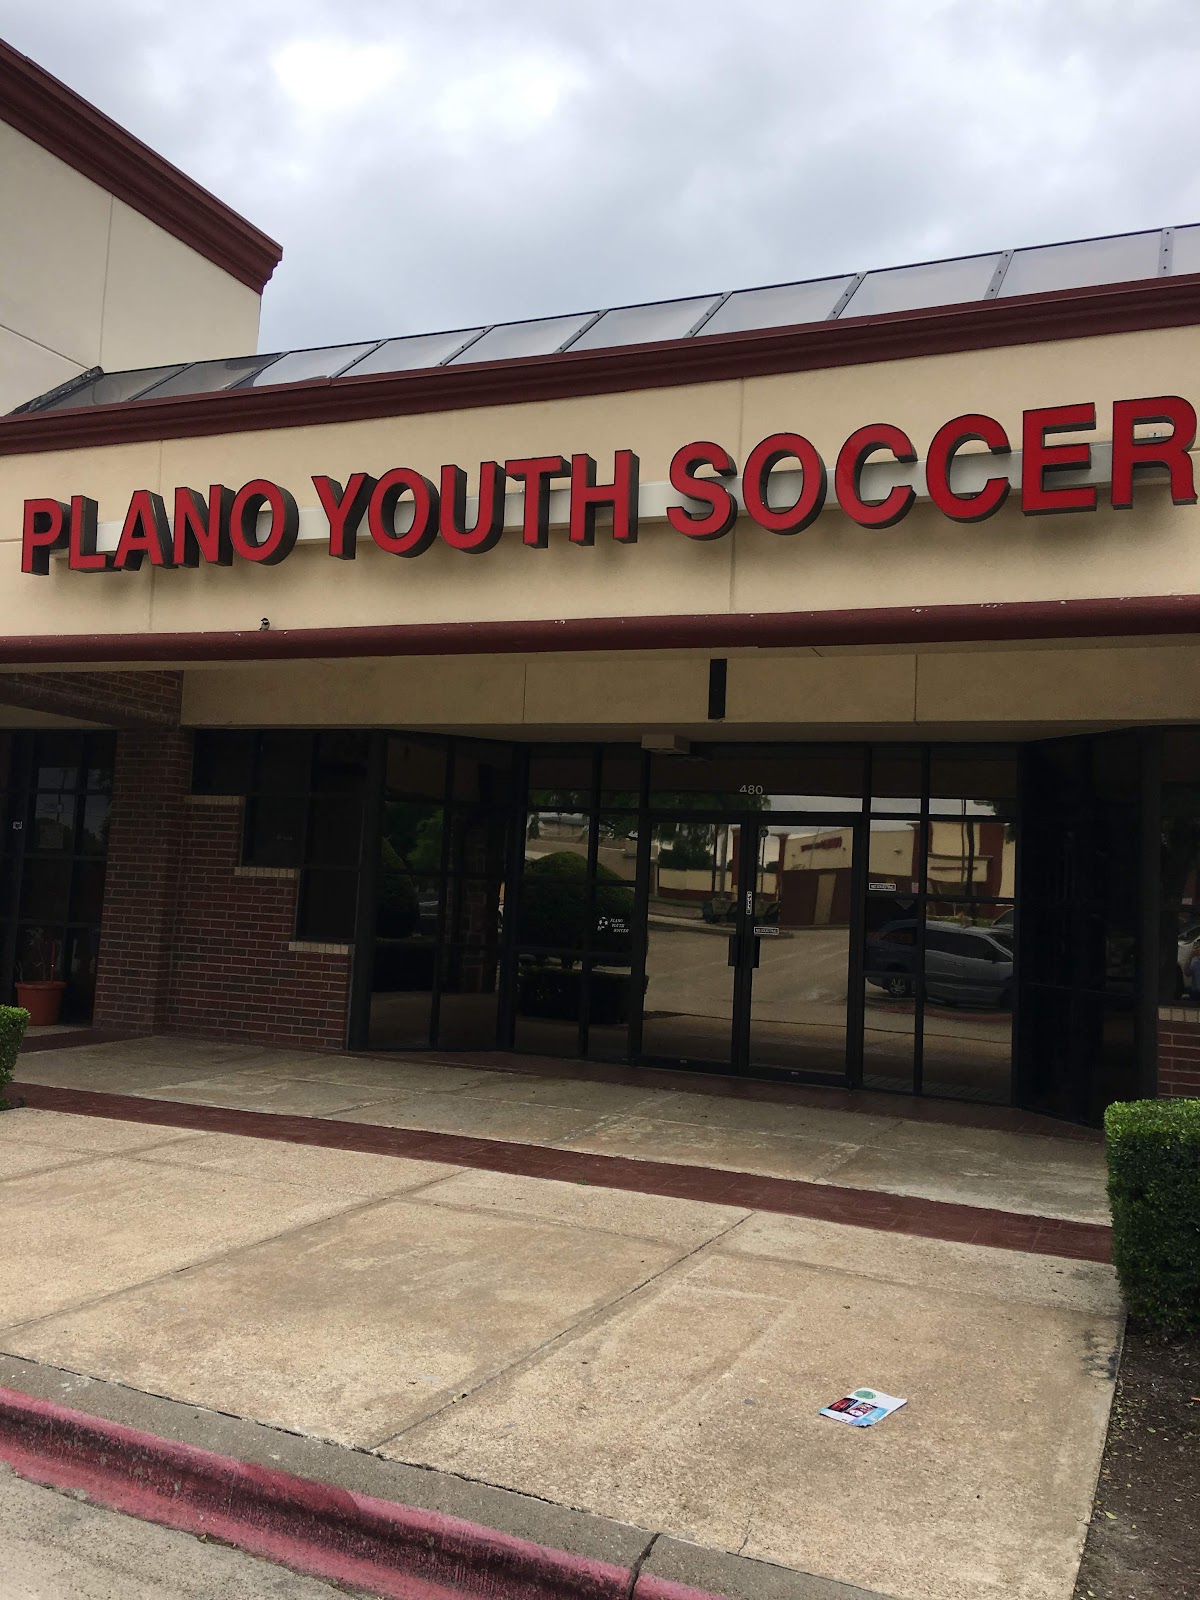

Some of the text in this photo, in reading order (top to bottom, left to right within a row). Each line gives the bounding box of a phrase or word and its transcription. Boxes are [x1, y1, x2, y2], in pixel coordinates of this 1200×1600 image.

[21, 395, 1198, 575] PLANO YOUTH SOCCER
[739, 784, 764, 795] 480
